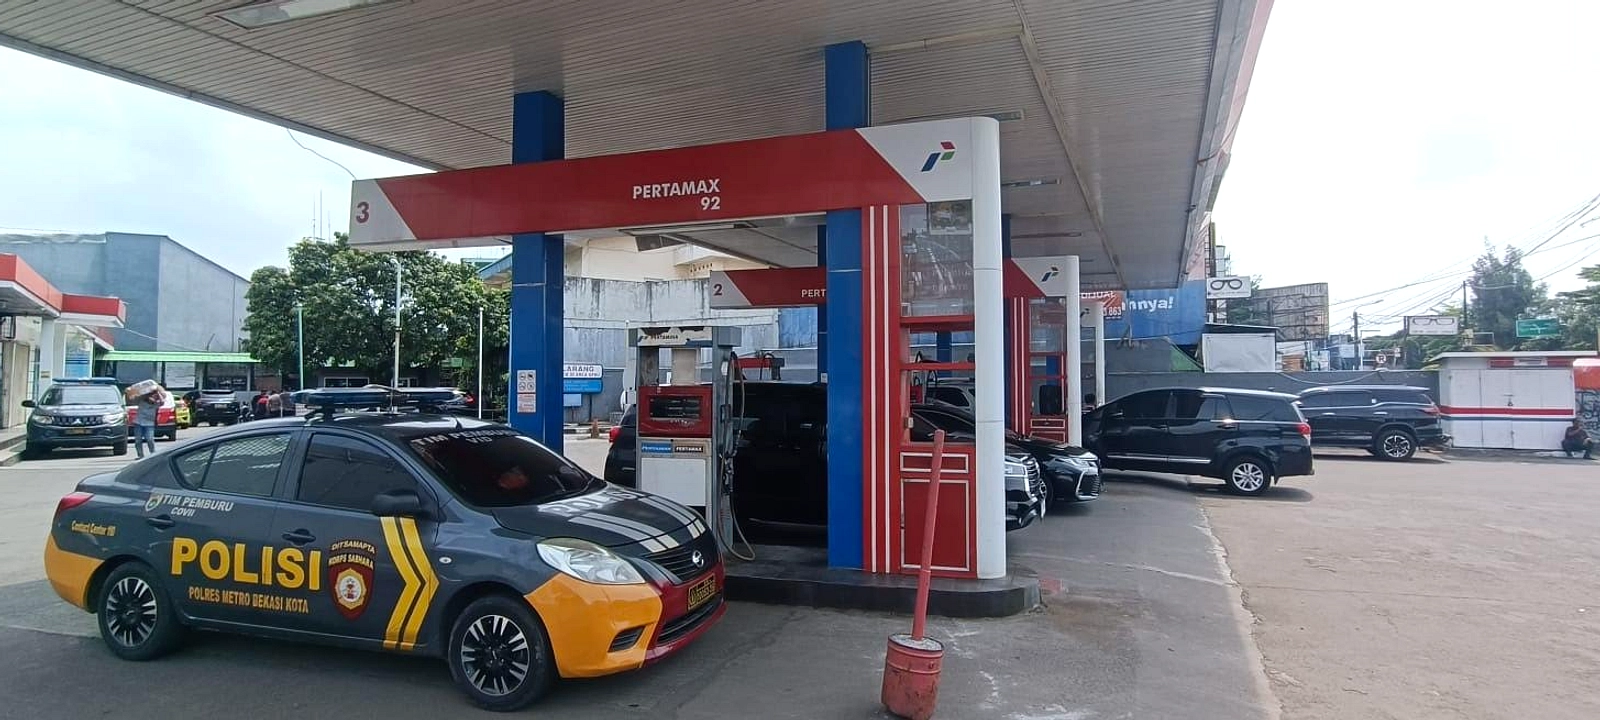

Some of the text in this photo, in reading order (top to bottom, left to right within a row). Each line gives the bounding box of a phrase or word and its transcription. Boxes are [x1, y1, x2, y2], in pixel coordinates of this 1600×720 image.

[633, 178, 720, 199] PERTAMAX
[356, 201, 370, 223] 3
[700, 196, 720, 210] 92
[713, 283, 723, 296] 2
[162, 495, 234, 512] TIM PEMBURU
[171, 537, 321, 591] POLISI
[188, 586, 309, 614] POLRES METRO BEKASI KOTA
